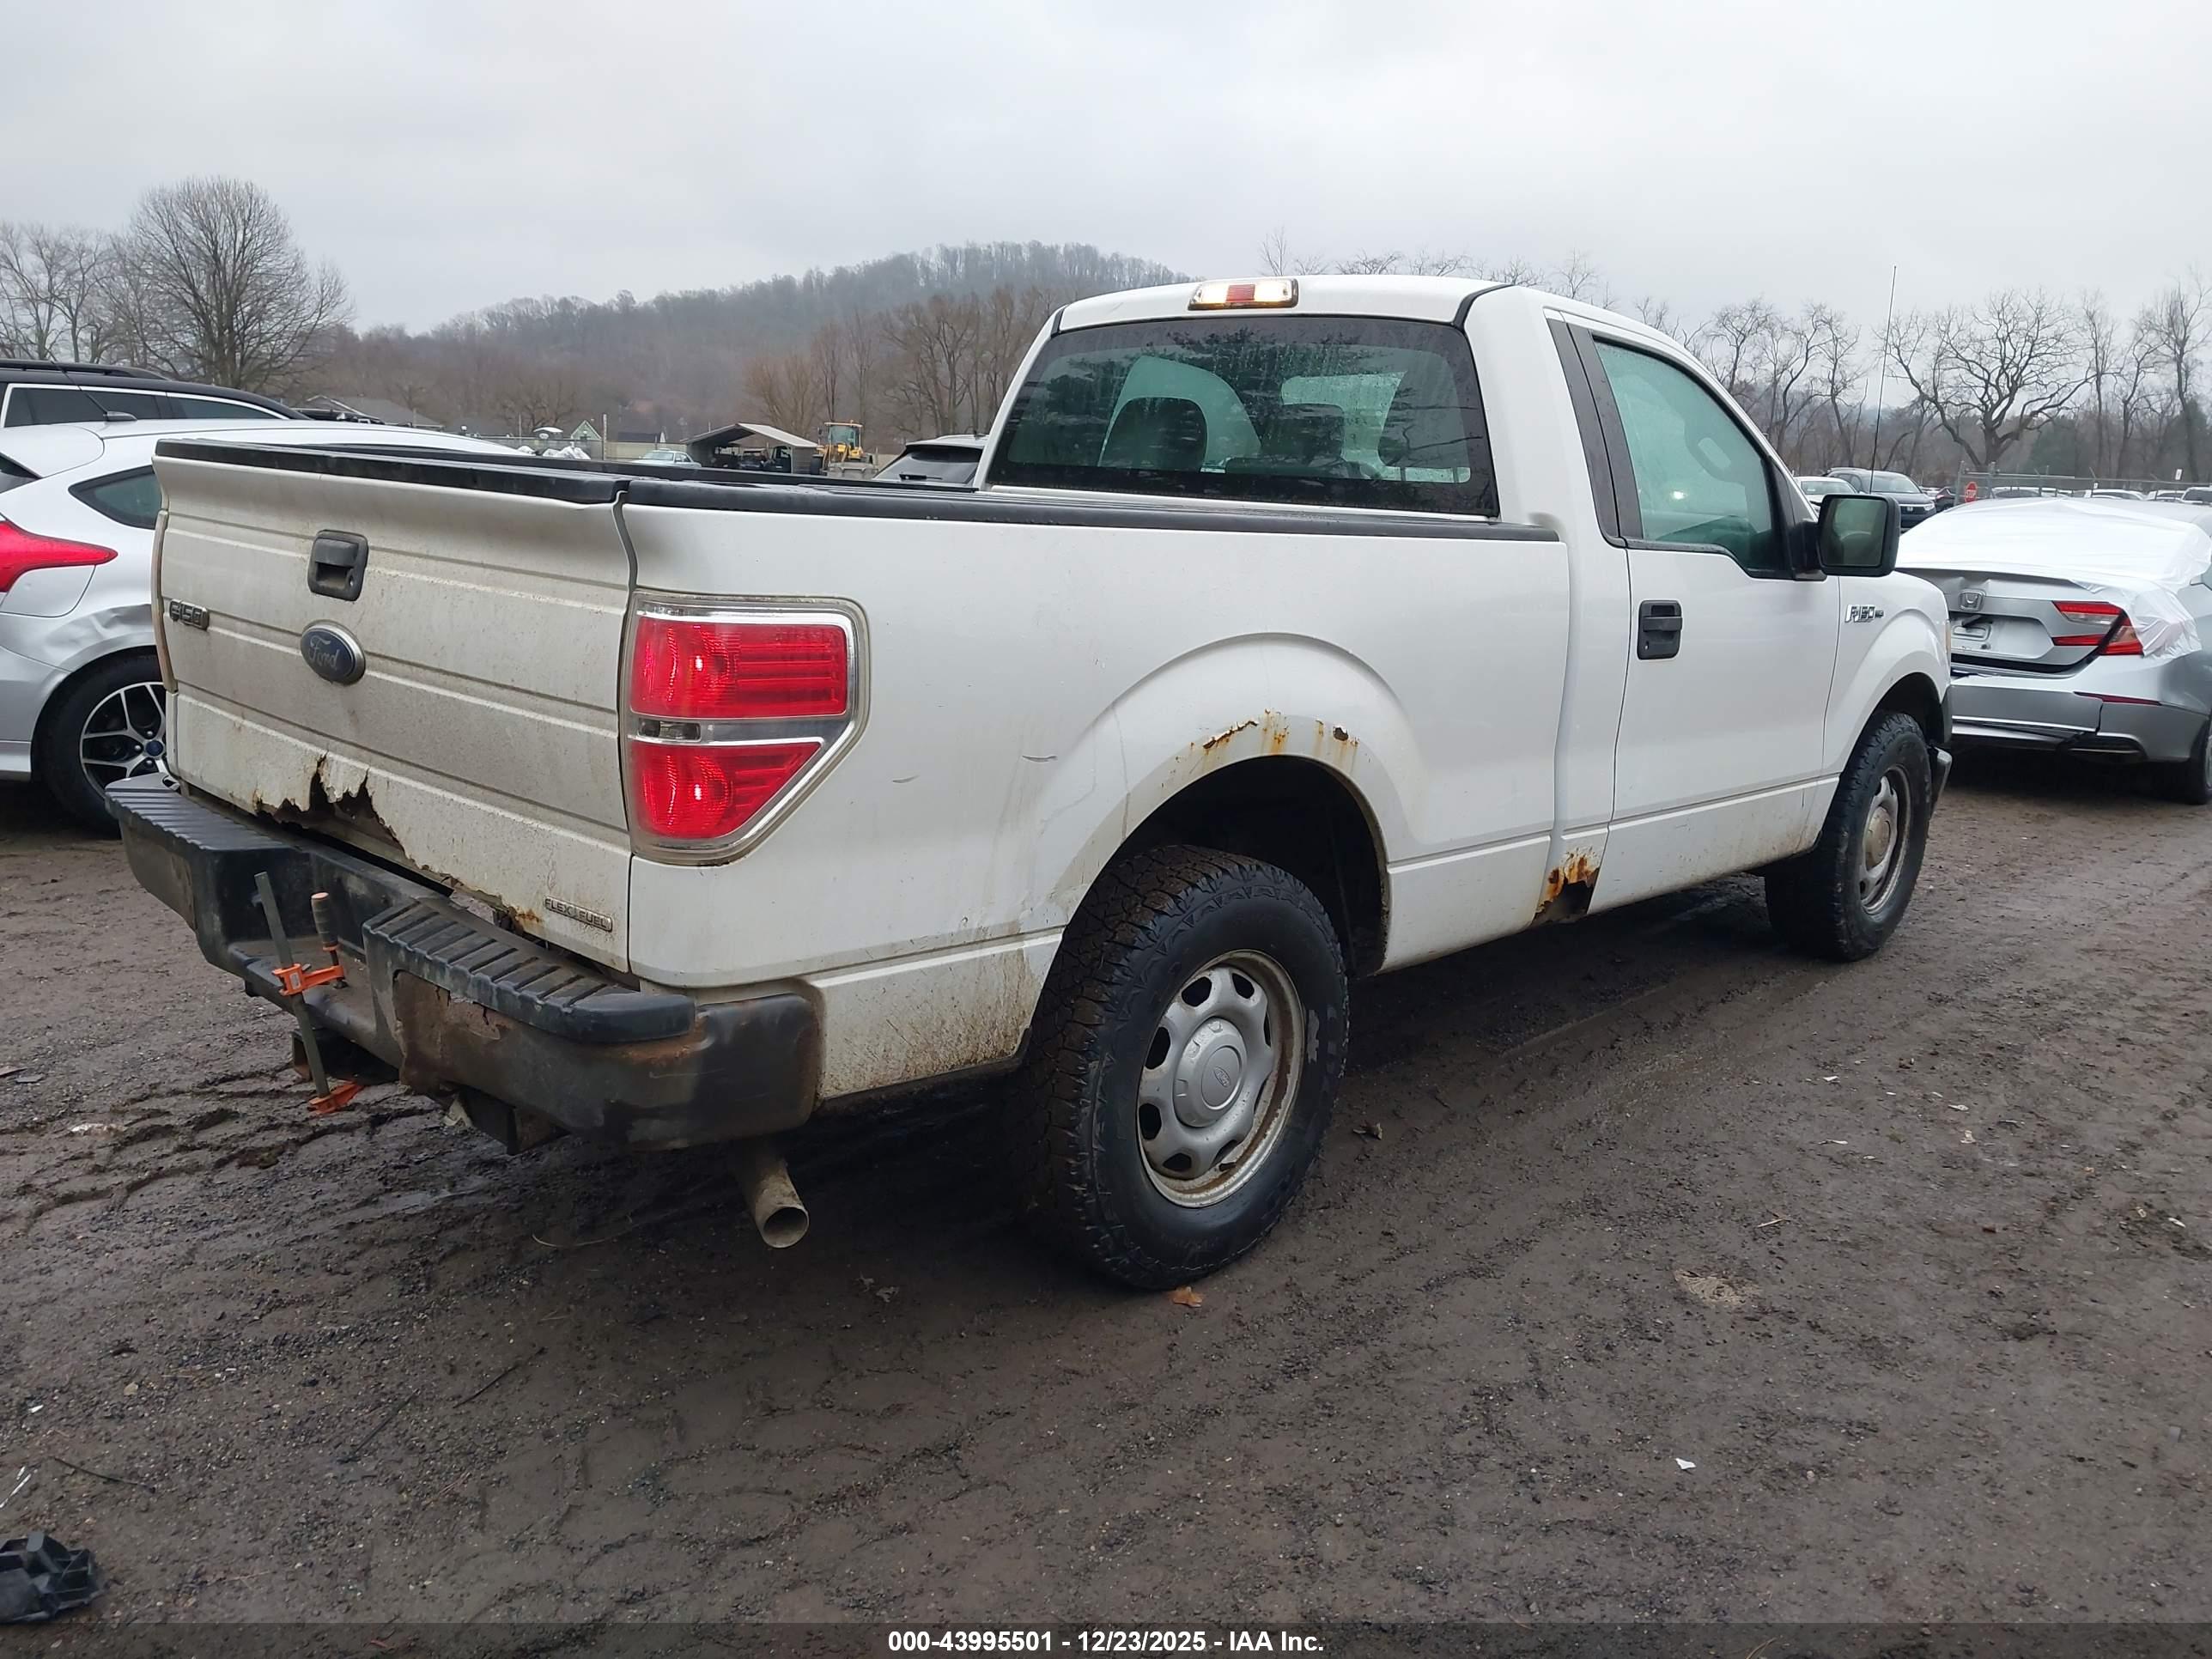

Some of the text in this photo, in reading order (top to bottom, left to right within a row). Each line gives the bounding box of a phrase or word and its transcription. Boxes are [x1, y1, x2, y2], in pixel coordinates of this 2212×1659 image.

[309, 635, 342, 671] Ford
[544, 897, 609, 930] FLEX FUEL
